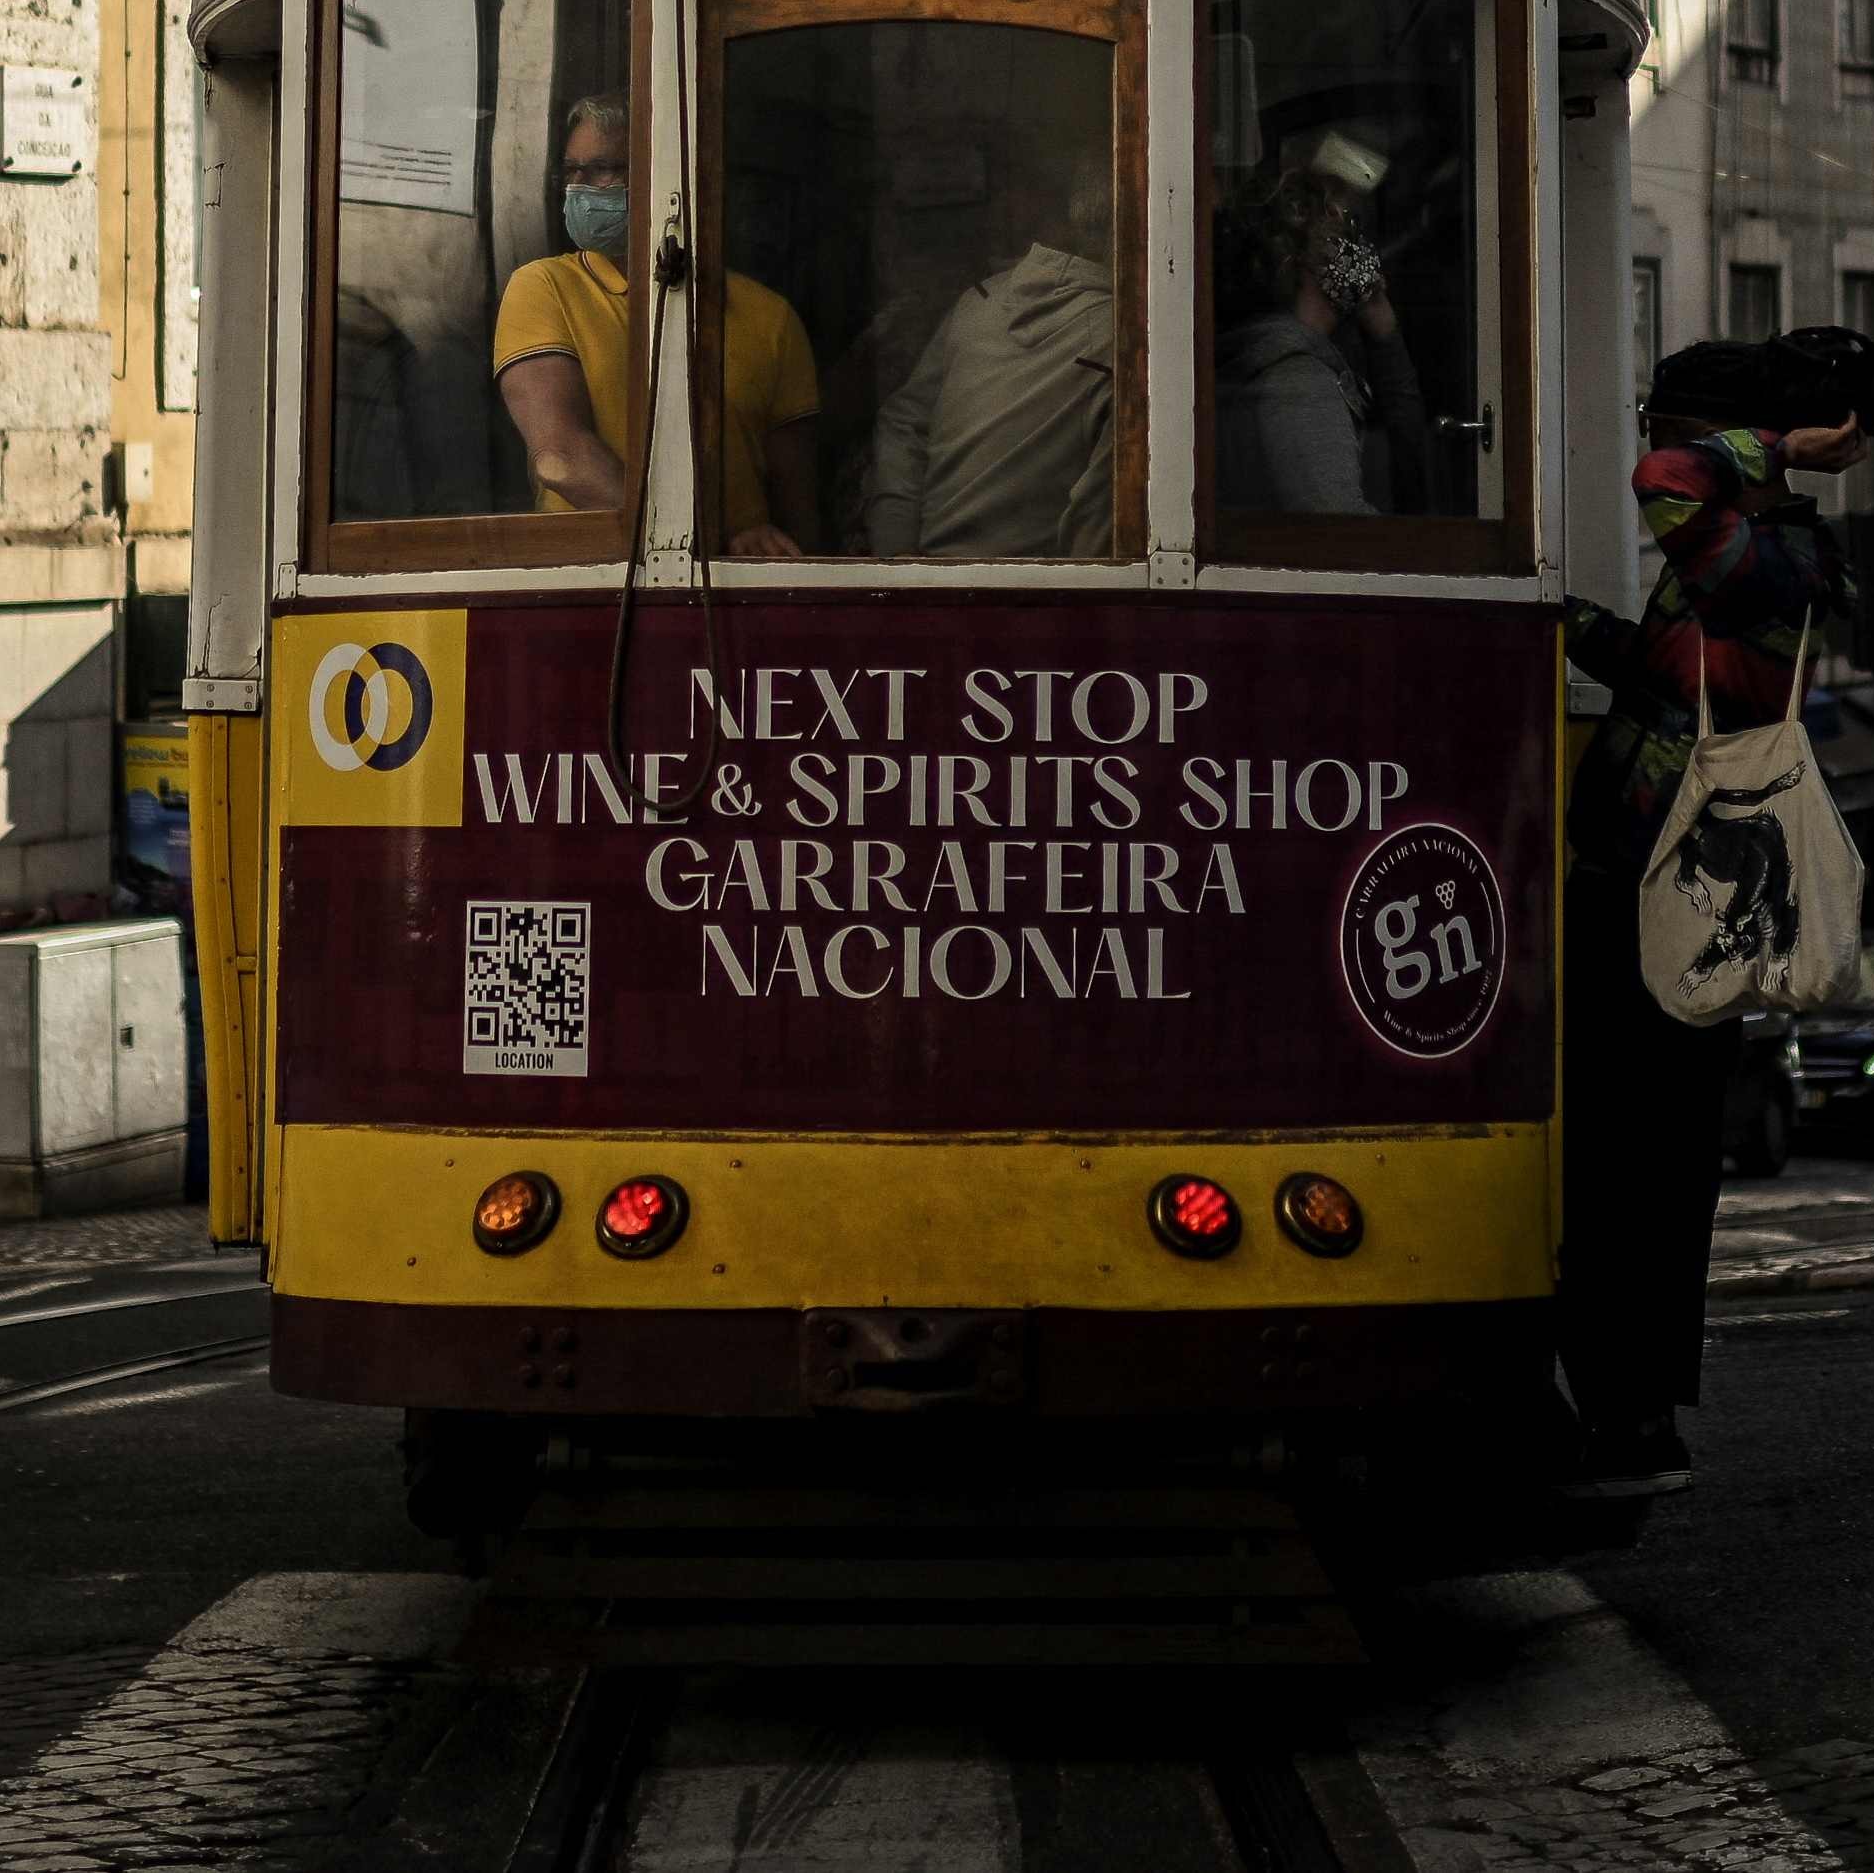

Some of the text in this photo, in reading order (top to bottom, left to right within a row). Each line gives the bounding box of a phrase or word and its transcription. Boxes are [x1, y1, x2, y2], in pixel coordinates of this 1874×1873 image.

[690, 668, 1209, 745] NEXT STOP
[472, 752, 1411, 832] WINE & SPIRITS SHOP
[645, 837, 1246, 914] GARRAFEIRA
[701, 924, 1192, 1000] NACIONAL
[1374, 893, 1483, 1000] gn
[494, 1052, 554, 1070] LOCATION
